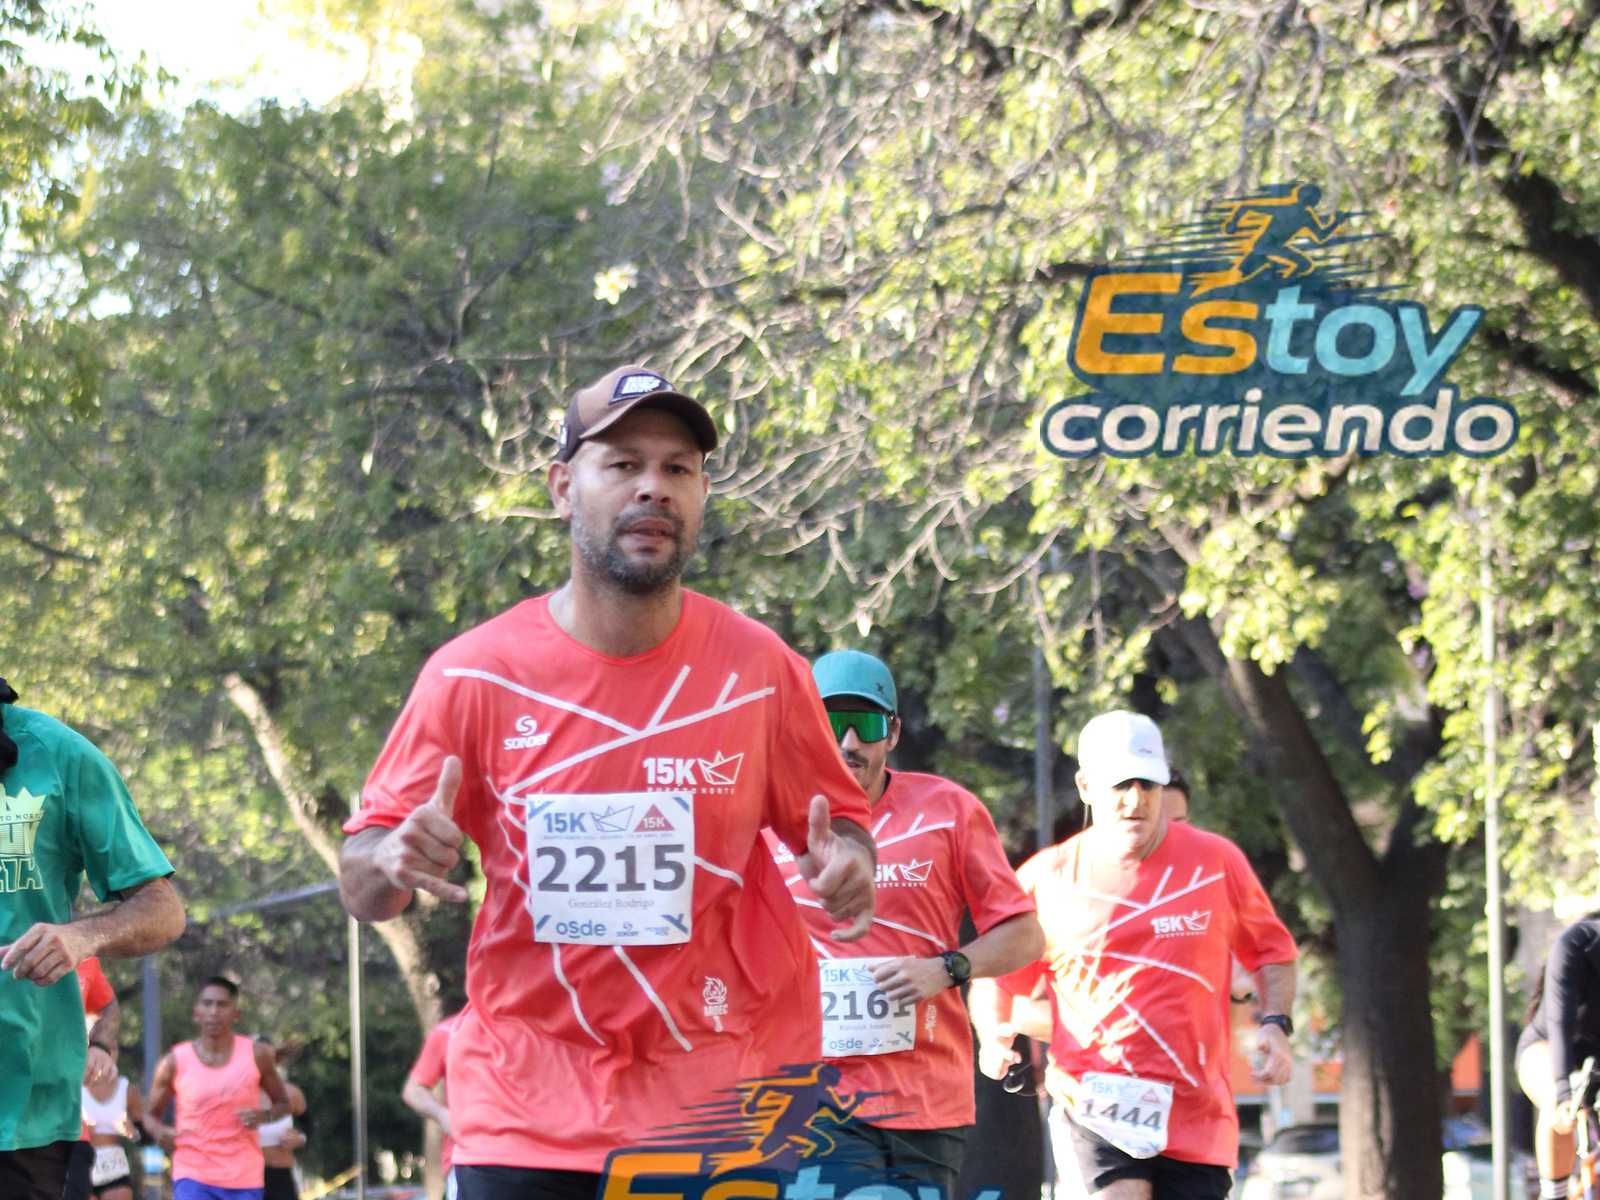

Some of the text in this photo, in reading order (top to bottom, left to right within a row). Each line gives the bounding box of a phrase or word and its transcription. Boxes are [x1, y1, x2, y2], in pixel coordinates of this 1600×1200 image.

[643, 757, 697, 784] 15K
[544, 812, 587, 833] 15K
[643, 817, 666, 829] 15K
[535, 844, 687, 893] 2215
[1151, 915, 1184, 935] 15K
[824, 968, 850, 982] 15K
[1080, 1098, 1162, 1132] 1444
